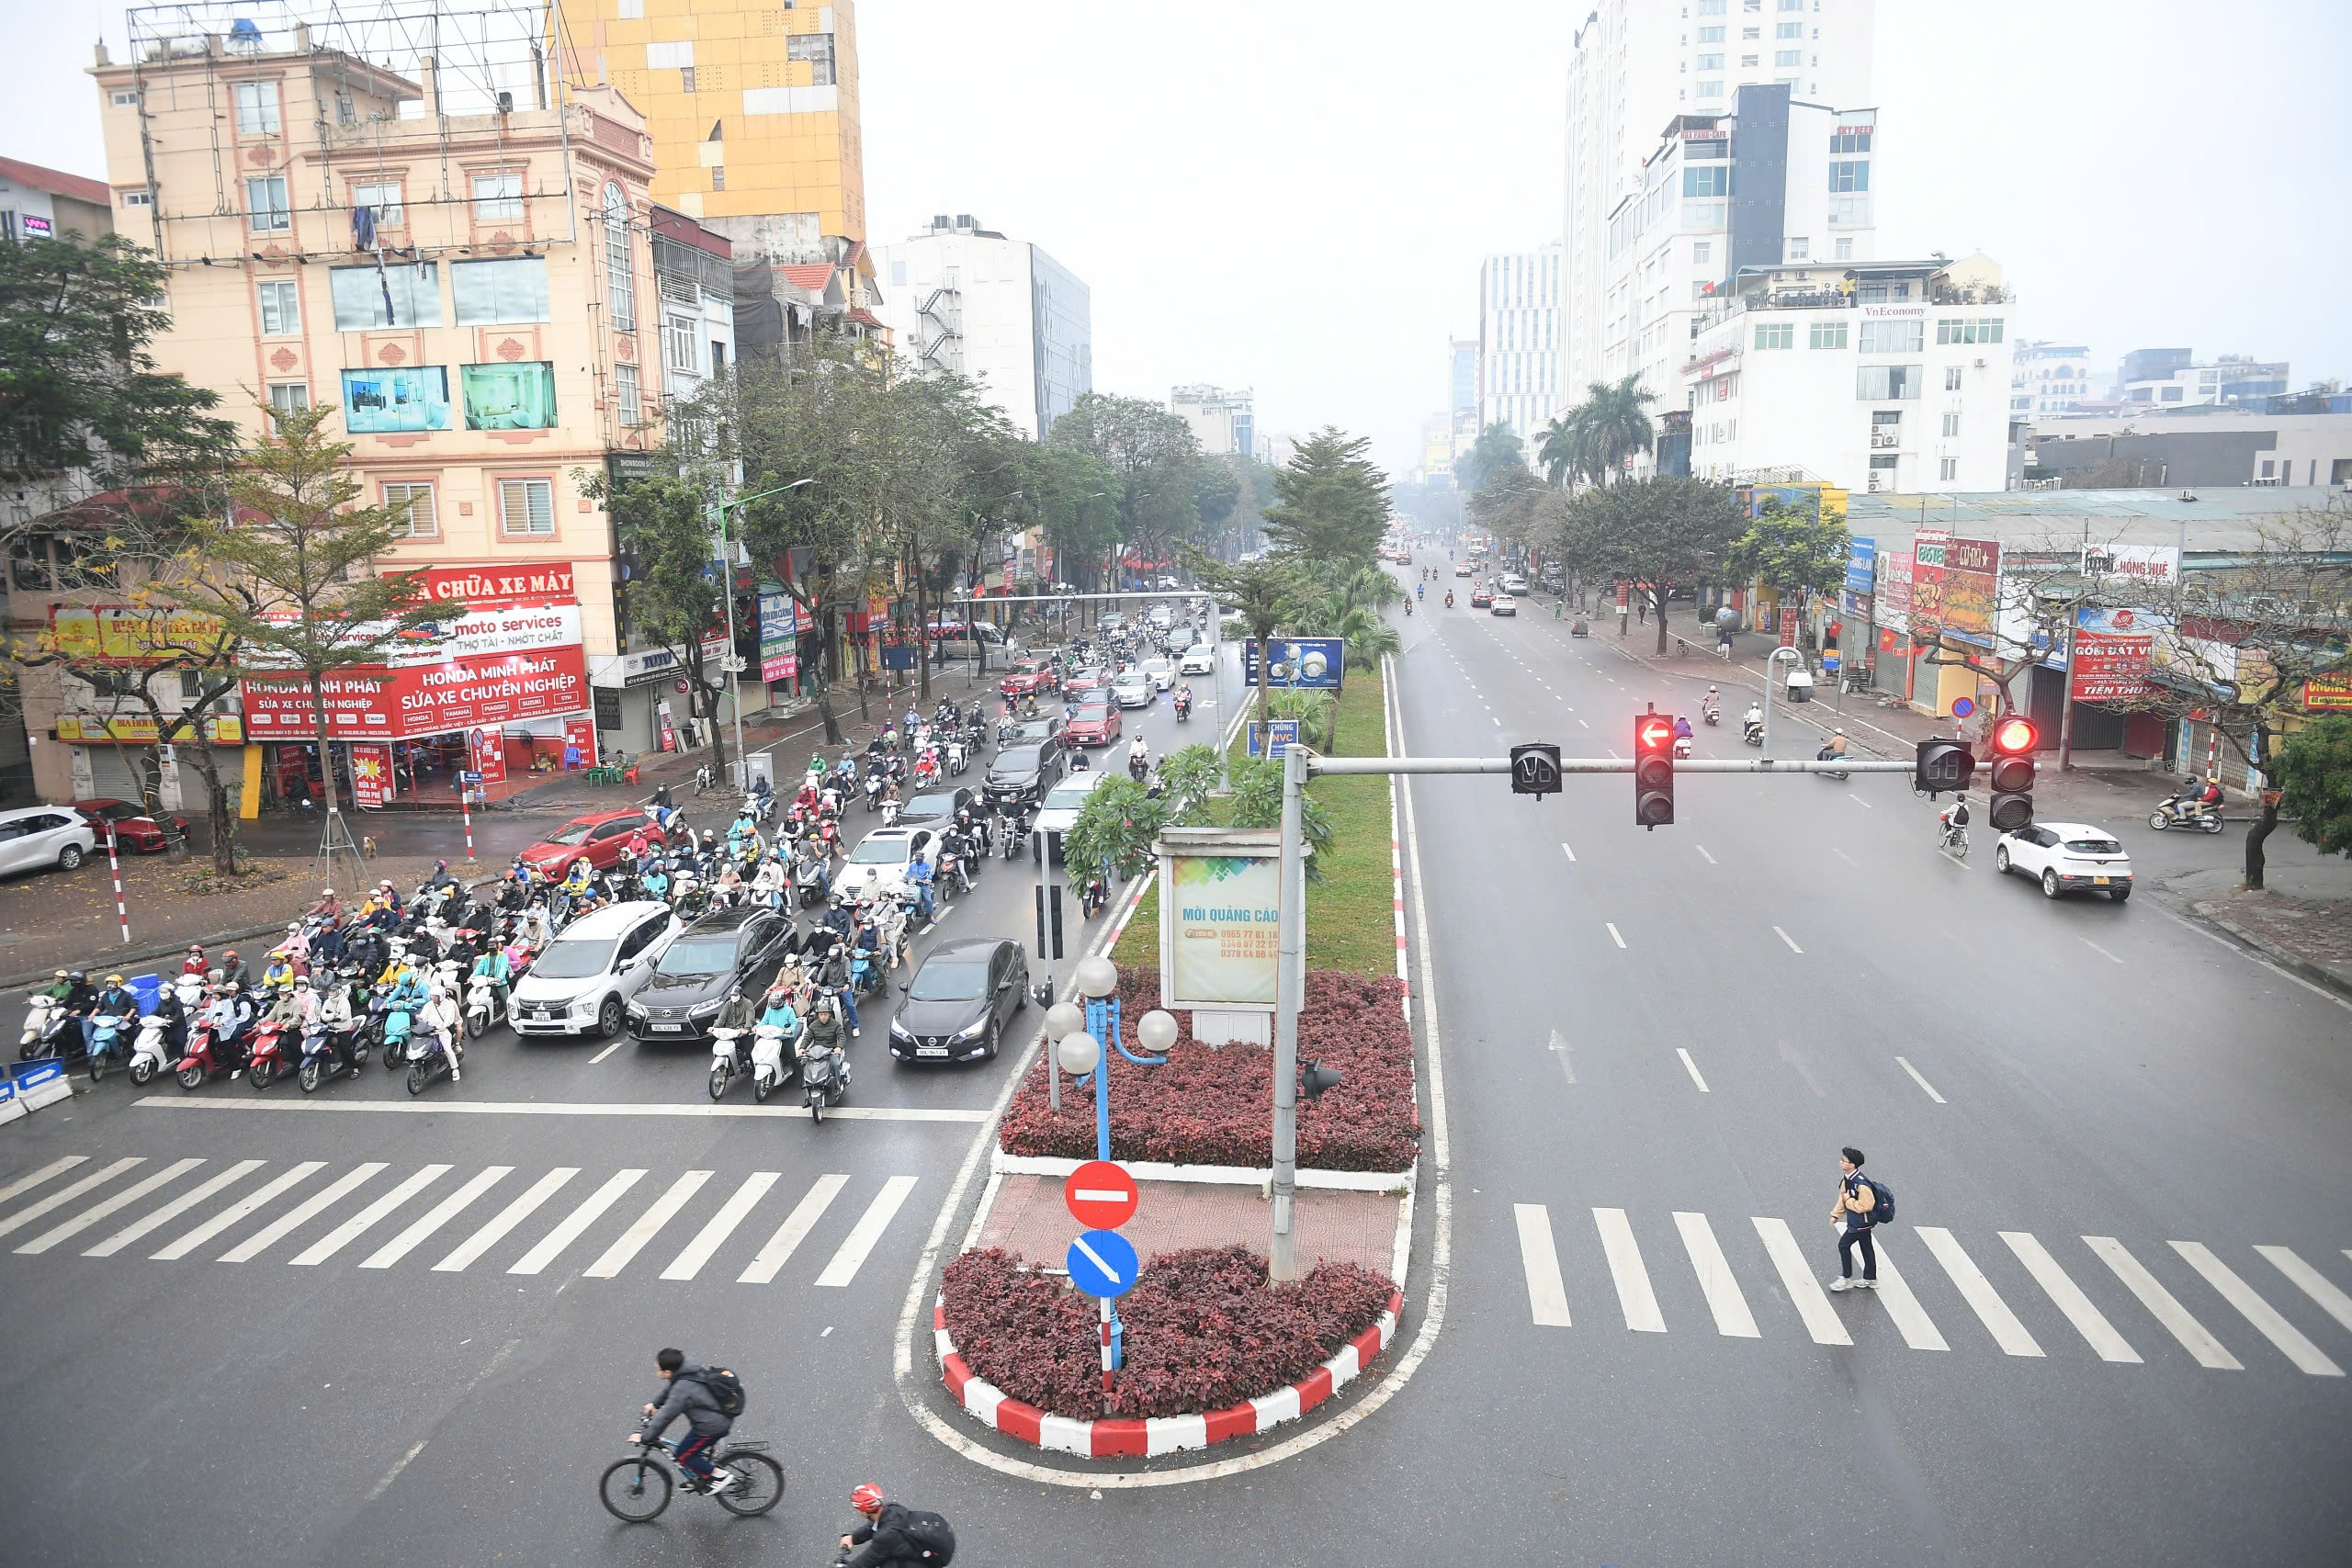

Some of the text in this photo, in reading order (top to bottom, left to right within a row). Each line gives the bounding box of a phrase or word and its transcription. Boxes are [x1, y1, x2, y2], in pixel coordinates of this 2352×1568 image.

[1865, 306, 1926, 317] VnEconomy
[2120, 557, 2145, 574] HỒNG
[2150, 561, 2168, 579] HUỆ
[436, 573, 495, 598] CHỮA
[499, 577, 526, 594] XE
[530, 570, 572, 592] MÁY
[455, 615, 561, 636] moto services
[456, 640, 480, 651] THỢ
[481, 637, 497, 648] TÀI
[508, 633, 535, 645] NHỚT
[537, 631, 563, 643] CHẤT
[2075, 644, 2105, 655] GỐM
[642, 652, 672, 670] TOTO
[423, 657, 556, 687] HONDA MINH PHÁT
[246, 679, 381, 694] HONDA MNH PHÁT
[401, 673, 576, 710] SỬA XE CHUYÊN NGHIỆP
[258, 696, 373, 711] SỬA XE CHUÊN NGHIỆP
[484, 704, 506, 712] PIAGGIO
[446, 709, 469, 717] YAMAHA
[1183, 905, 1278, 922] MỜI QUẢNG CÁO
[1255, 931, 1264, 939] 81
[1221, 940, 1241, 948] 0346
[1221, 949, 1240, 957] 0378
